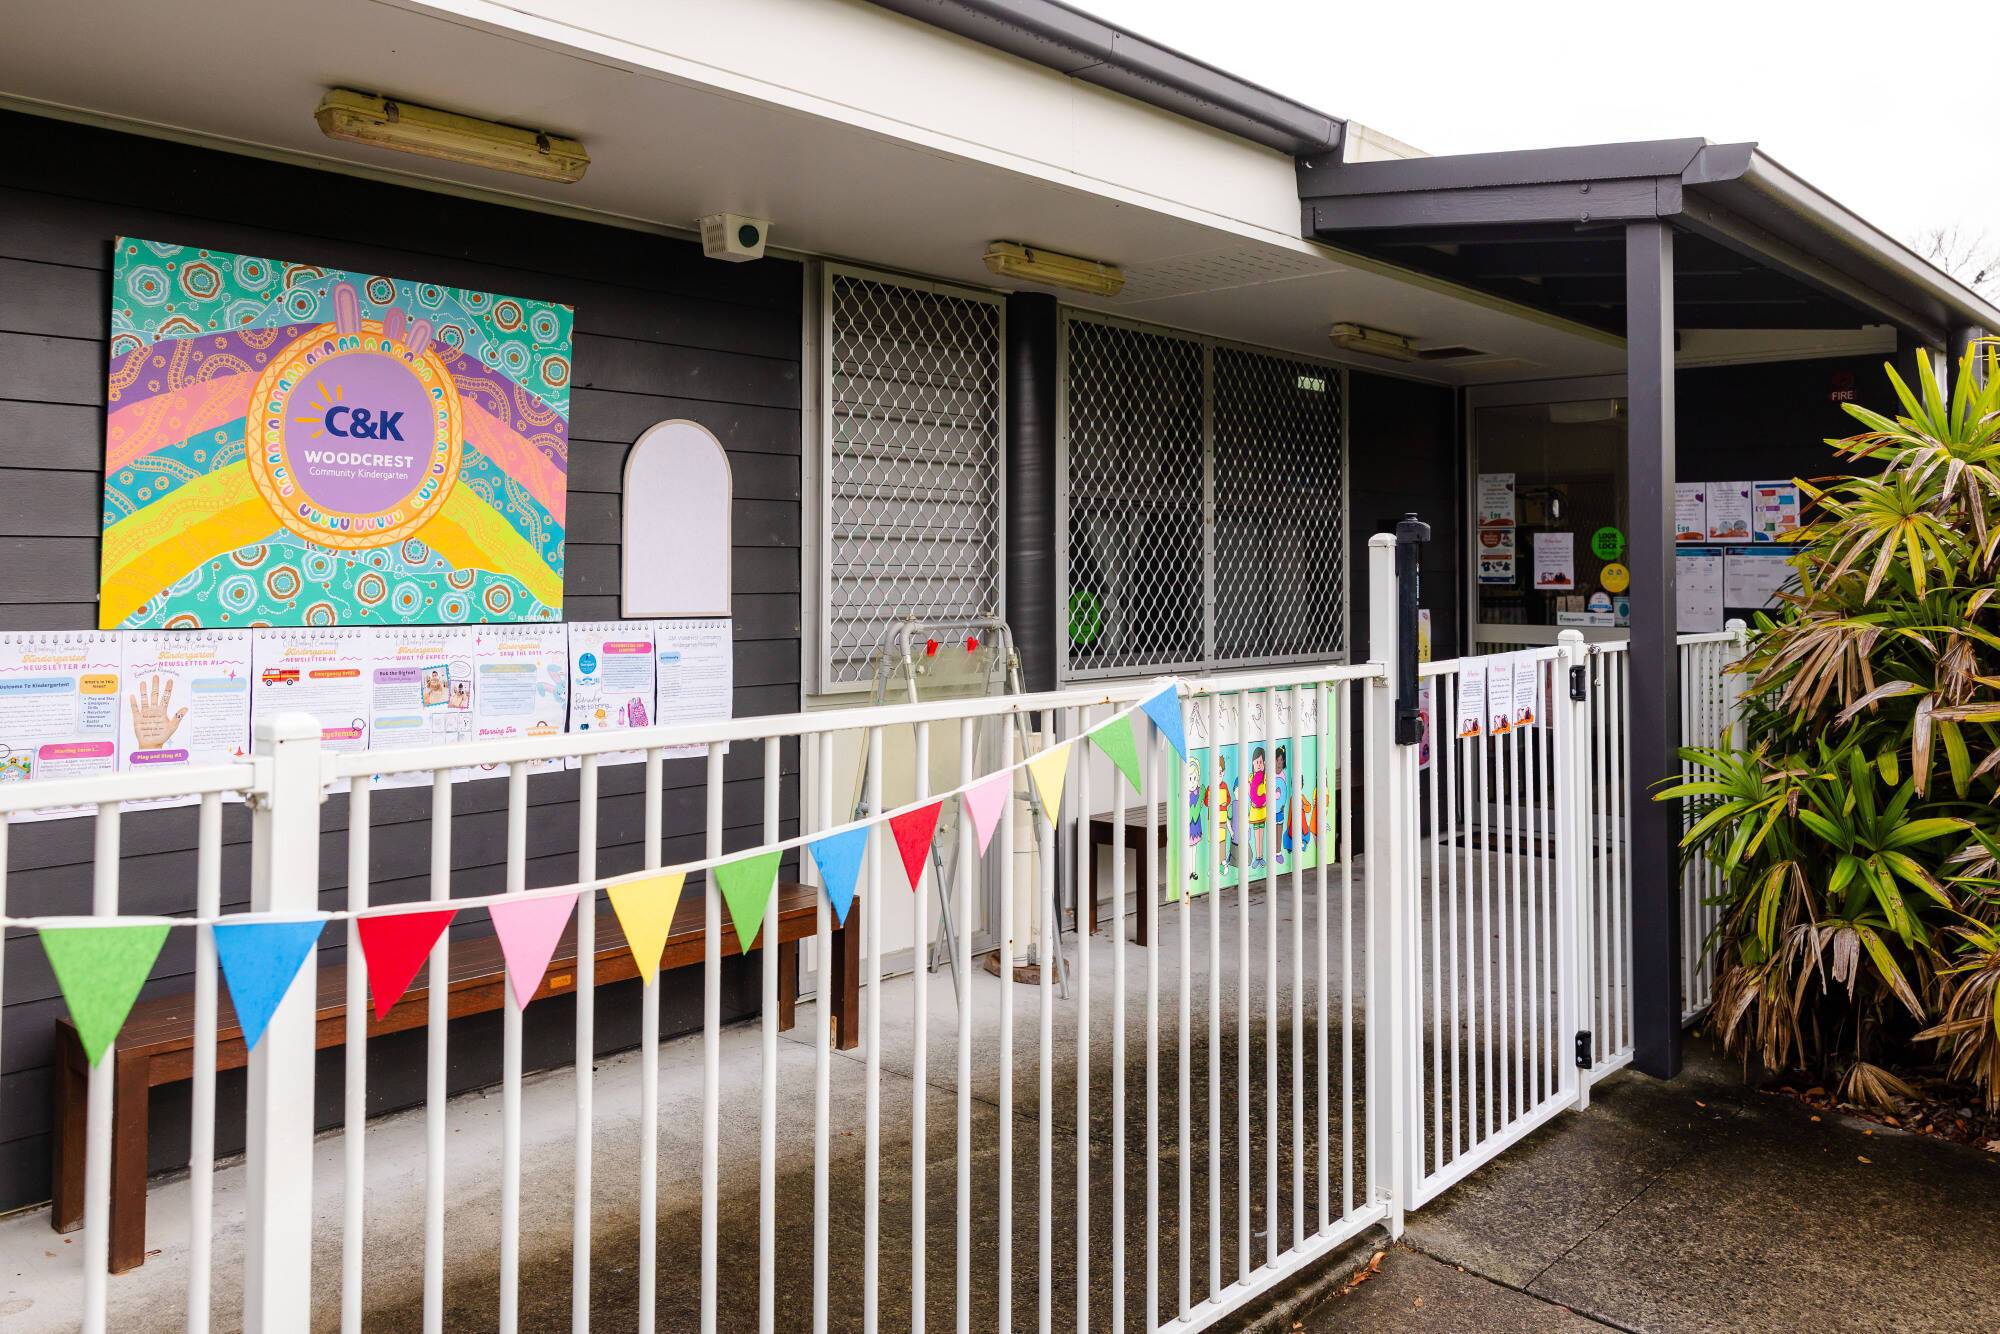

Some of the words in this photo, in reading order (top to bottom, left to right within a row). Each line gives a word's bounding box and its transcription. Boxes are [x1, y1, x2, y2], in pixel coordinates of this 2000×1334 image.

[1832, 391, 1853, 400] FIRE
[325, 405, 405, 441] C&K
[304, 450, 413, 468] WOODCREST
[309, 466, 356, 479] Community
[358, 468, 408, 481] Kindergarten
[479, 728, 505, 736] Morning
